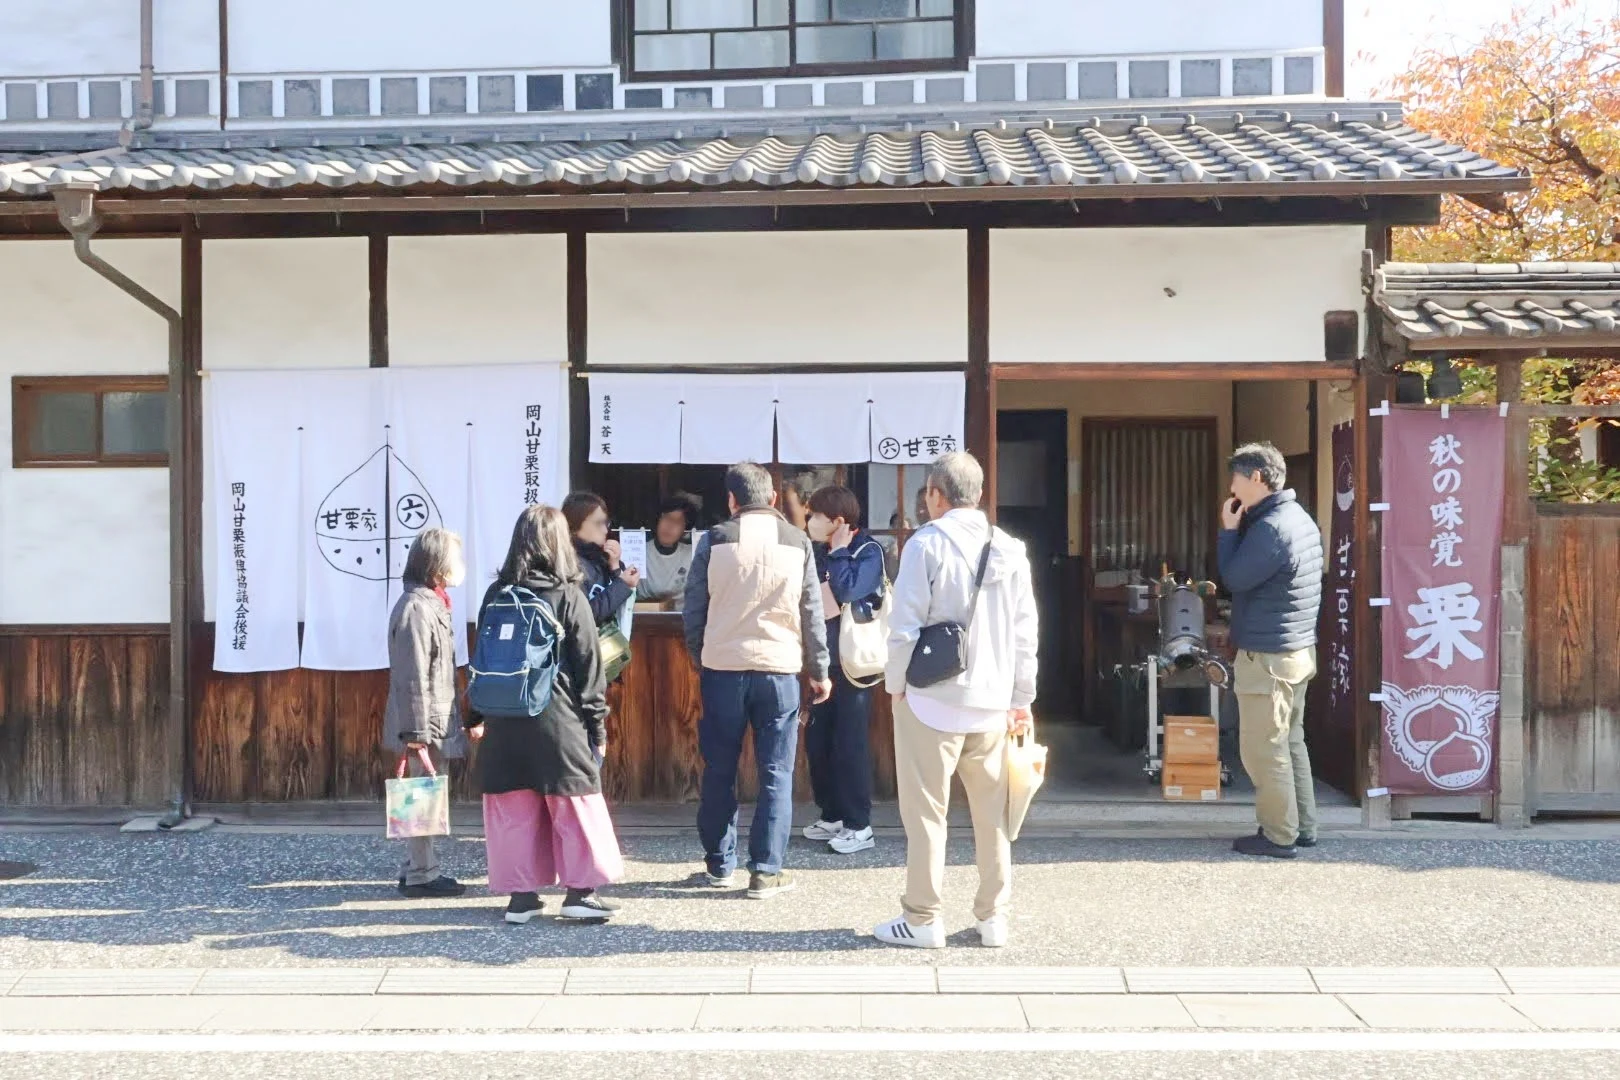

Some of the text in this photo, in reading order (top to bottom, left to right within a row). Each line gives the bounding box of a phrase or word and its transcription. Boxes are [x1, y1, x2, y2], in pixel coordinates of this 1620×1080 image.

[603, 394, 611, 421] 株式会社
[524, 404, 541, 506] 岡山甘栗取扱
[902, 434, 957, 457] 甘栗家
[320, 507, 377, 532] 甘栗家
[1428, 434, 1464, 567] 秋の味覚
[1403, 581, 1485, 670] 栗
